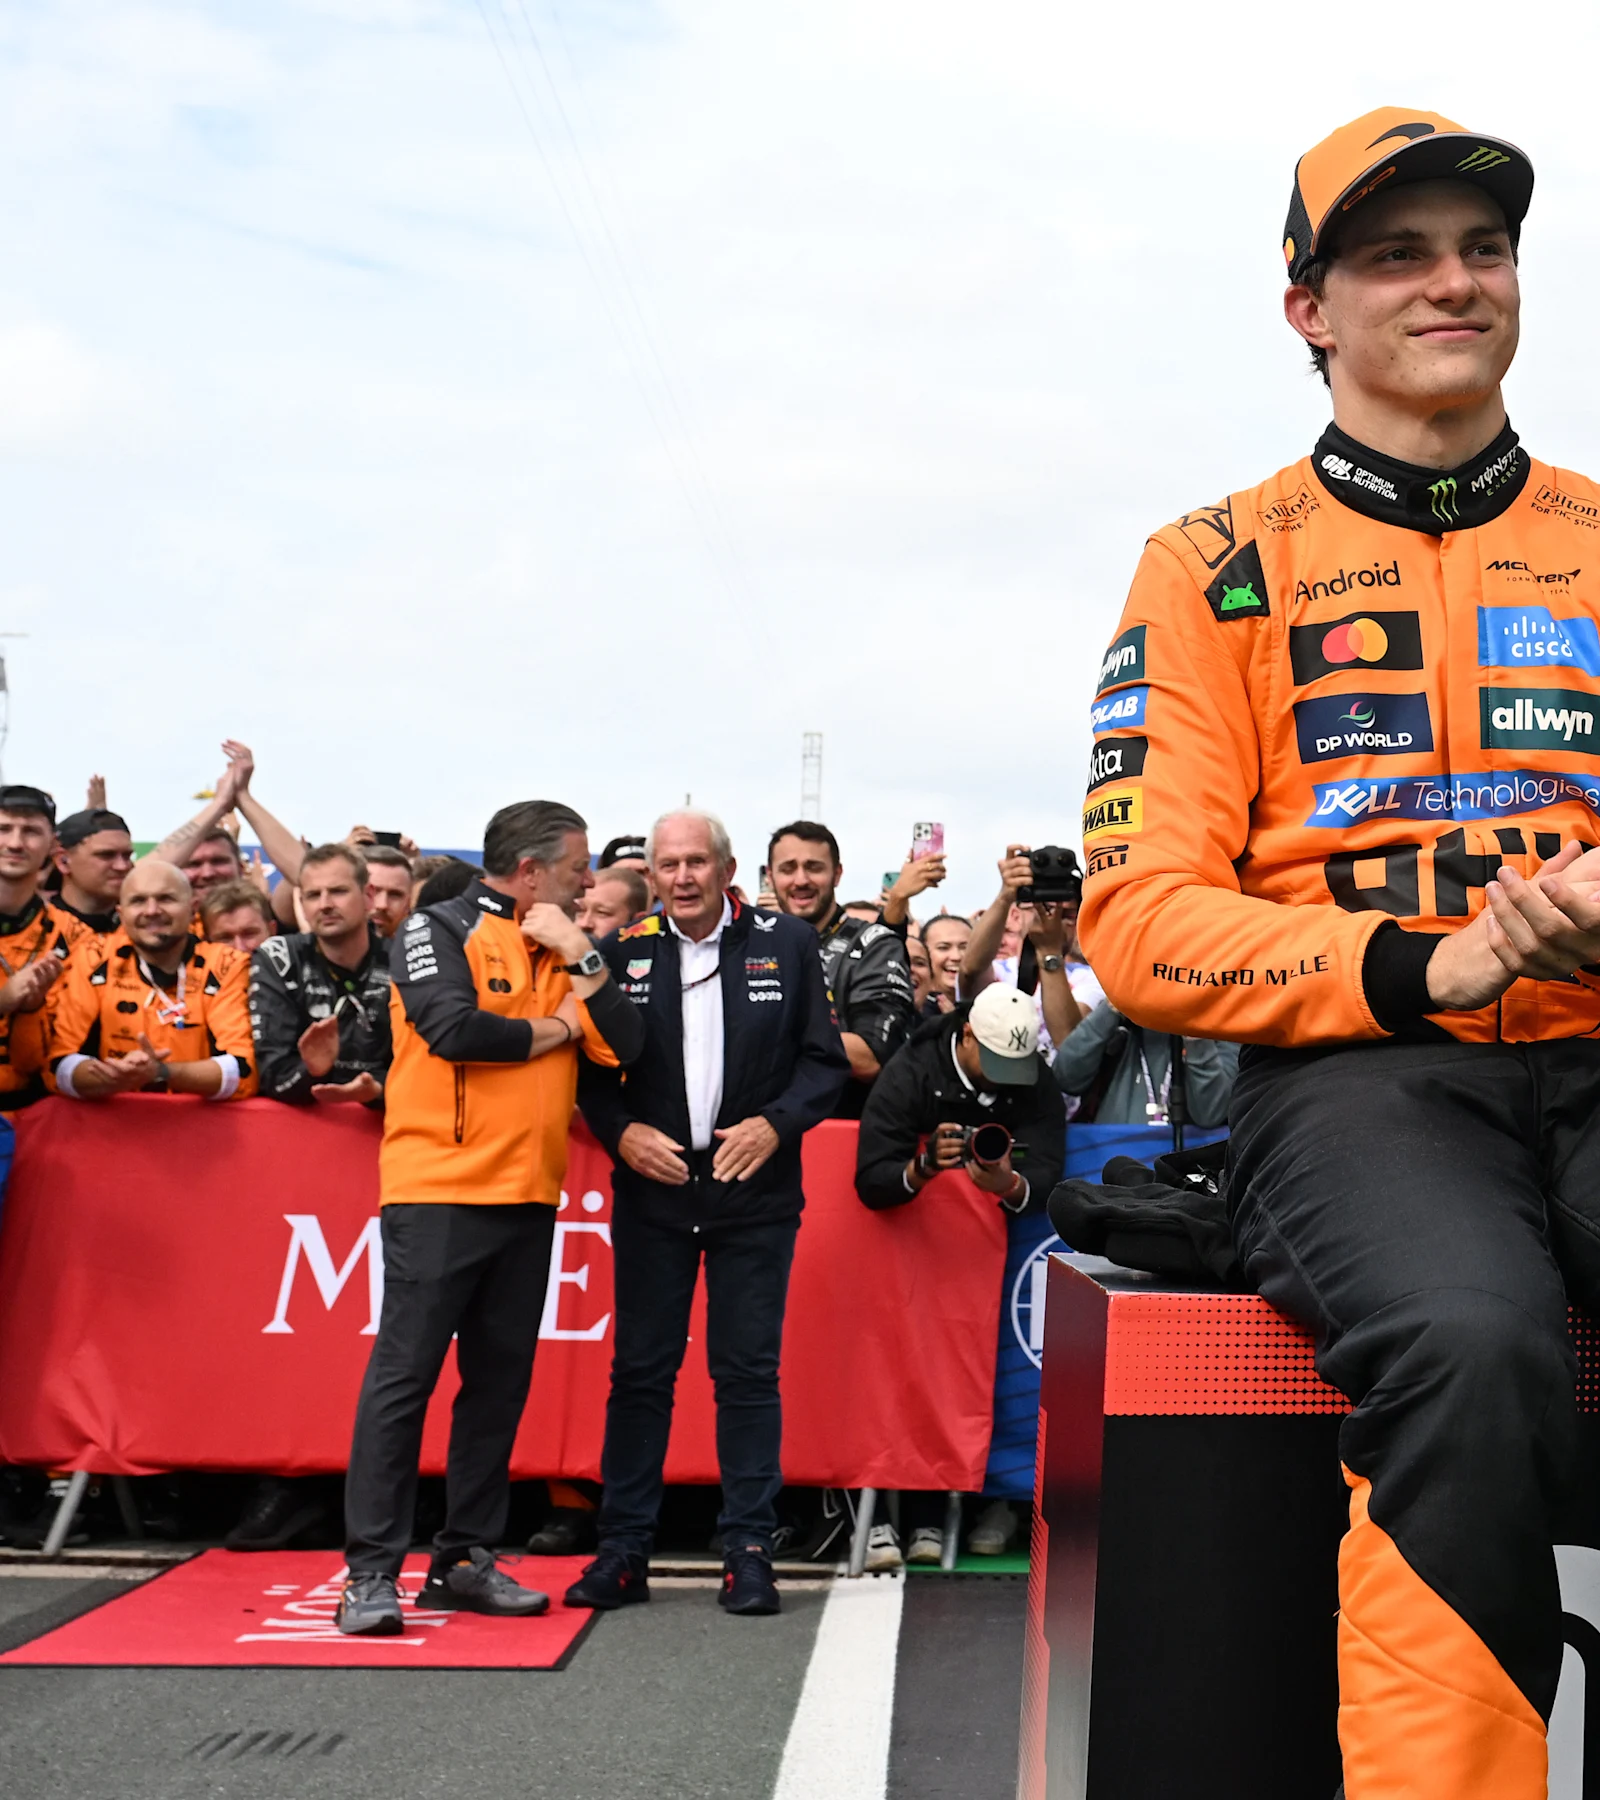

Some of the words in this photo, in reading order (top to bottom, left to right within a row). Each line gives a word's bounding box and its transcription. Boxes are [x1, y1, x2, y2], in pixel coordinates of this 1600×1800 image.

[1352, 475, 1398, 501] NUTRITION
[1355, 467, 1395, 491] OPTIMUM
[1264, 491, 1310, 521] Hilton
[1531, 502, 1550, 515] FOR
[1574, 518, 1599, 530] STAY
[1542, 490, 1598, 518] Hilton
[1294, 560, 1402, 605] Android
[1511, 639, 1573, 658] CISCO
[1492, 699, 1595, 741] allwyn
[1316, 737, 1343, 754] DP
[1344, 732, 1413, 748] WORLD
[1315, 783, 1402, 818] DELL
[1413, 776, 1600, 813] Technologies
[1084, 801, 1133, 833] WALT
[1086, 853, 1128, 877] ELLI
[1152, 962, 1254, 988] RICHARD
